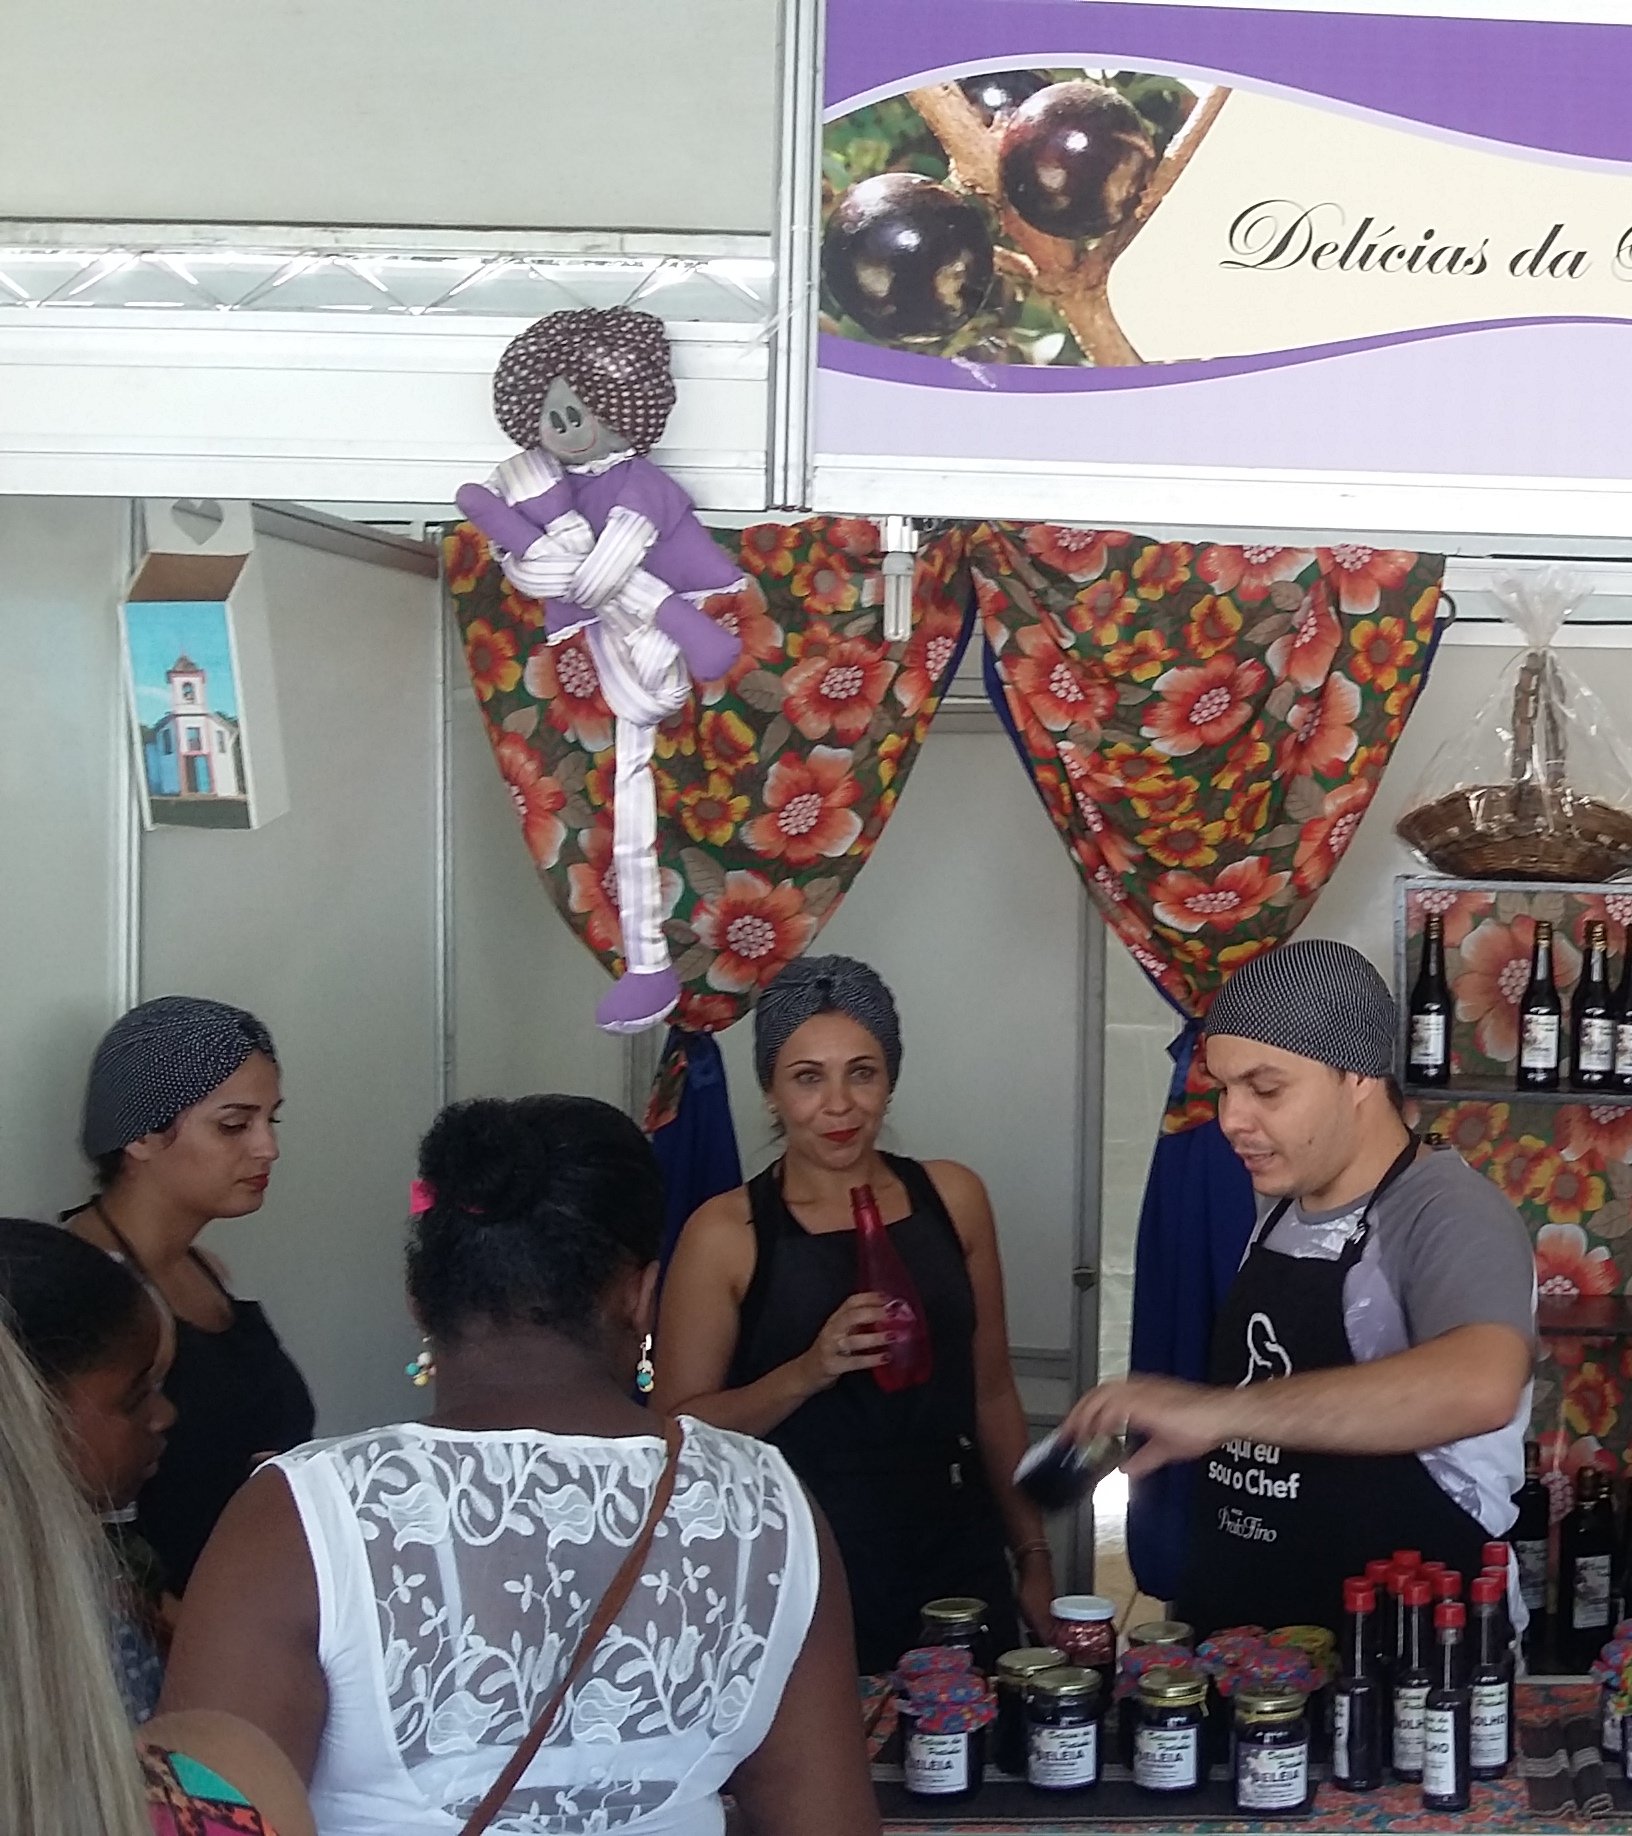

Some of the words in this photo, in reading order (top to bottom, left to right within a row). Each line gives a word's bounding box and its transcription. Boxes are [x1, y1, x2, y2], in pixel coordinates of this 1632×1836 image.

[1217, 199, 1489, 277] Delícias
[1507, 224, 1592, 280] da
[1254, 1443, 1280, 1465] eu
[1208, 1460, 1232, 1486] sou
[1232, 1471, 1243, 1490] o
[1245, 1468, 1300, 1499] Chef
